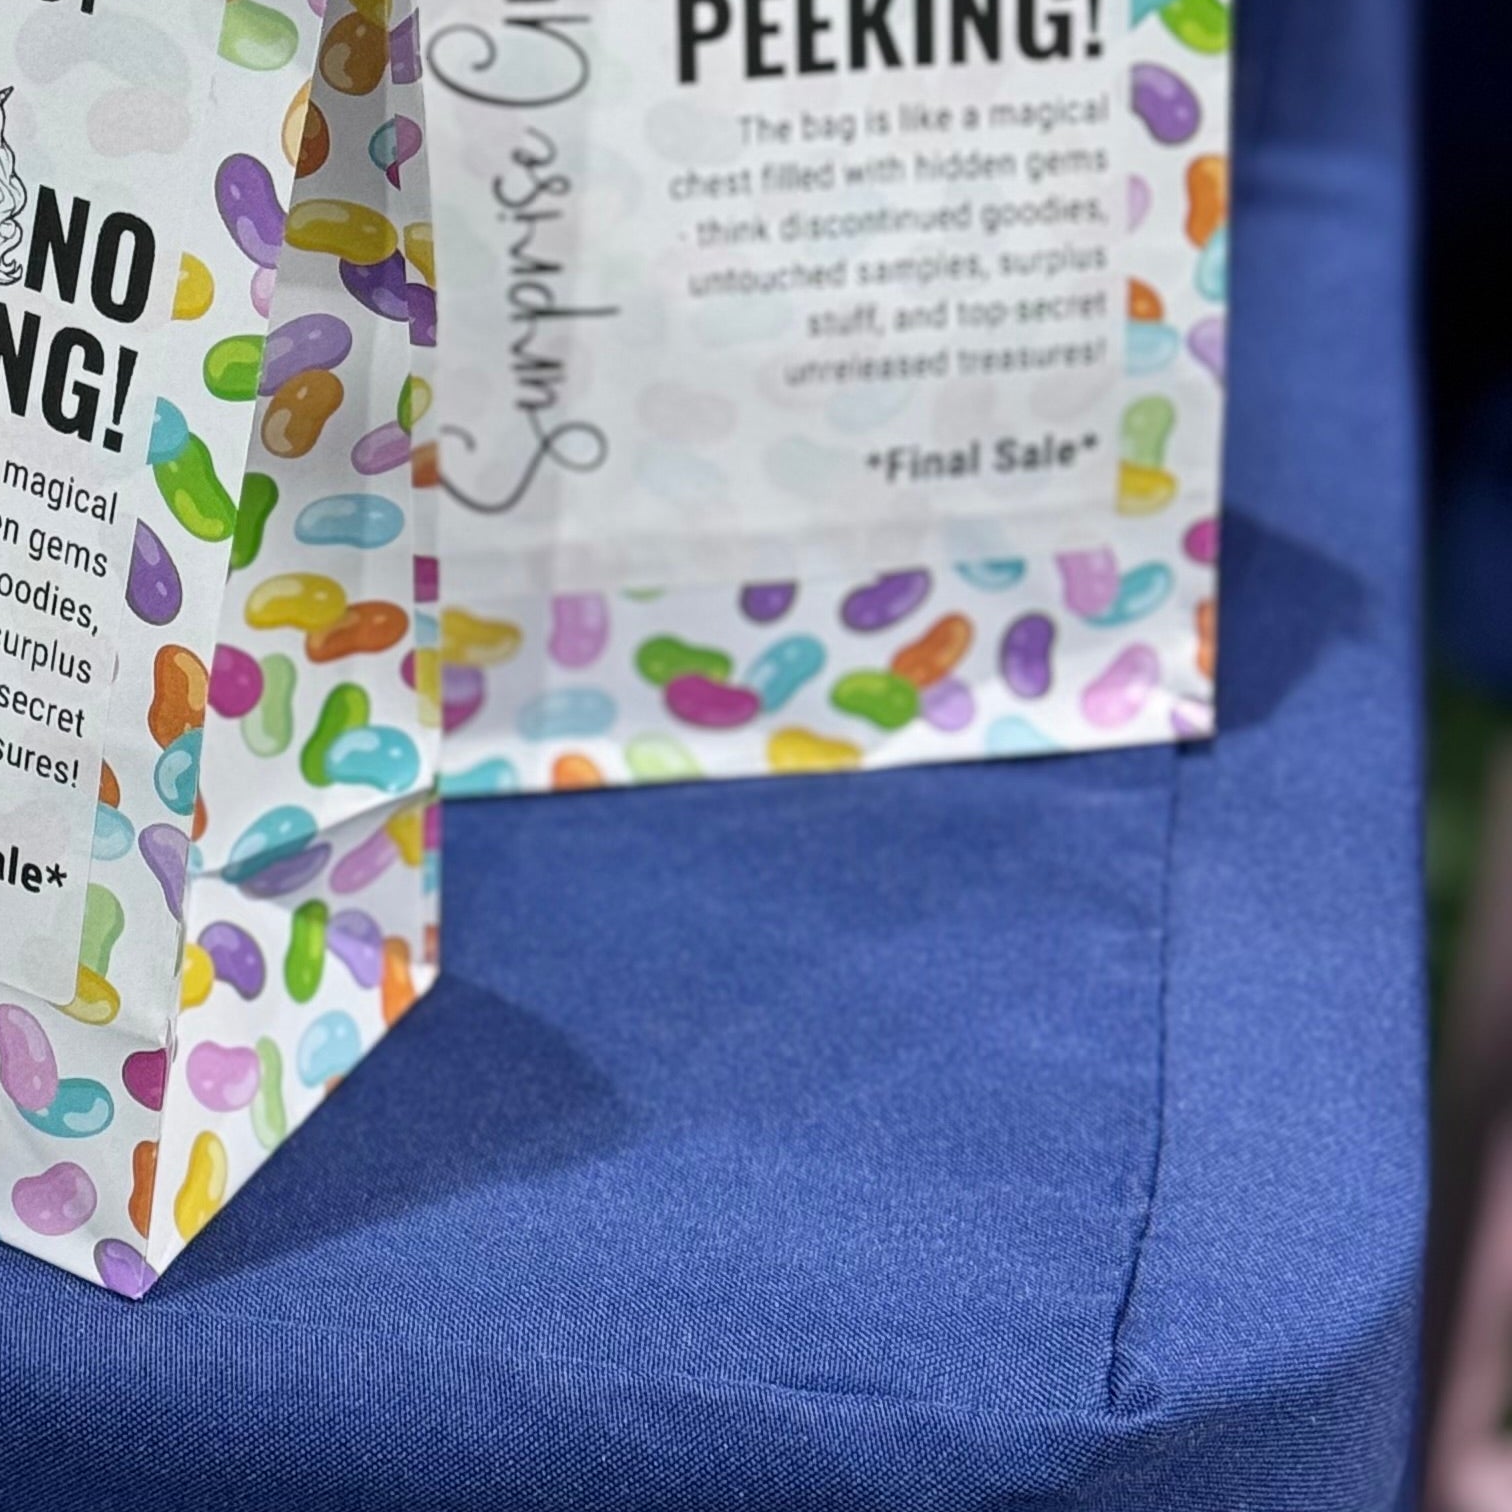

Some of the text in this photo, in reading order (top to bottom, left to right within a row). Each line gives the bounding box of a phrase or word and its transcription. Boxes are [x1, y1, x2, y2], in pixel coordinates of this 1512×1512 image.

[737, 93, 1110, 146] The bag is like a magical
[668, 148, 1110, 202] chest filled with hidden gems
[695, 218, 769, 248] think
[780, 201, 973, 243] discontinued
[979, 196, 1109, 237] goodies,
[24, 184, 157, 324] NO
[688, 245, 1108, 298] untouched samples, surplus
[436, 128, 621, 514] Surprise
[807, 290, 1107, 338] stuff, and top-secret
[783, 341, 1106, 389] unreleased treasures!
[2, 459, 118, 526] magical
[28, 528, 108, 578] gems
